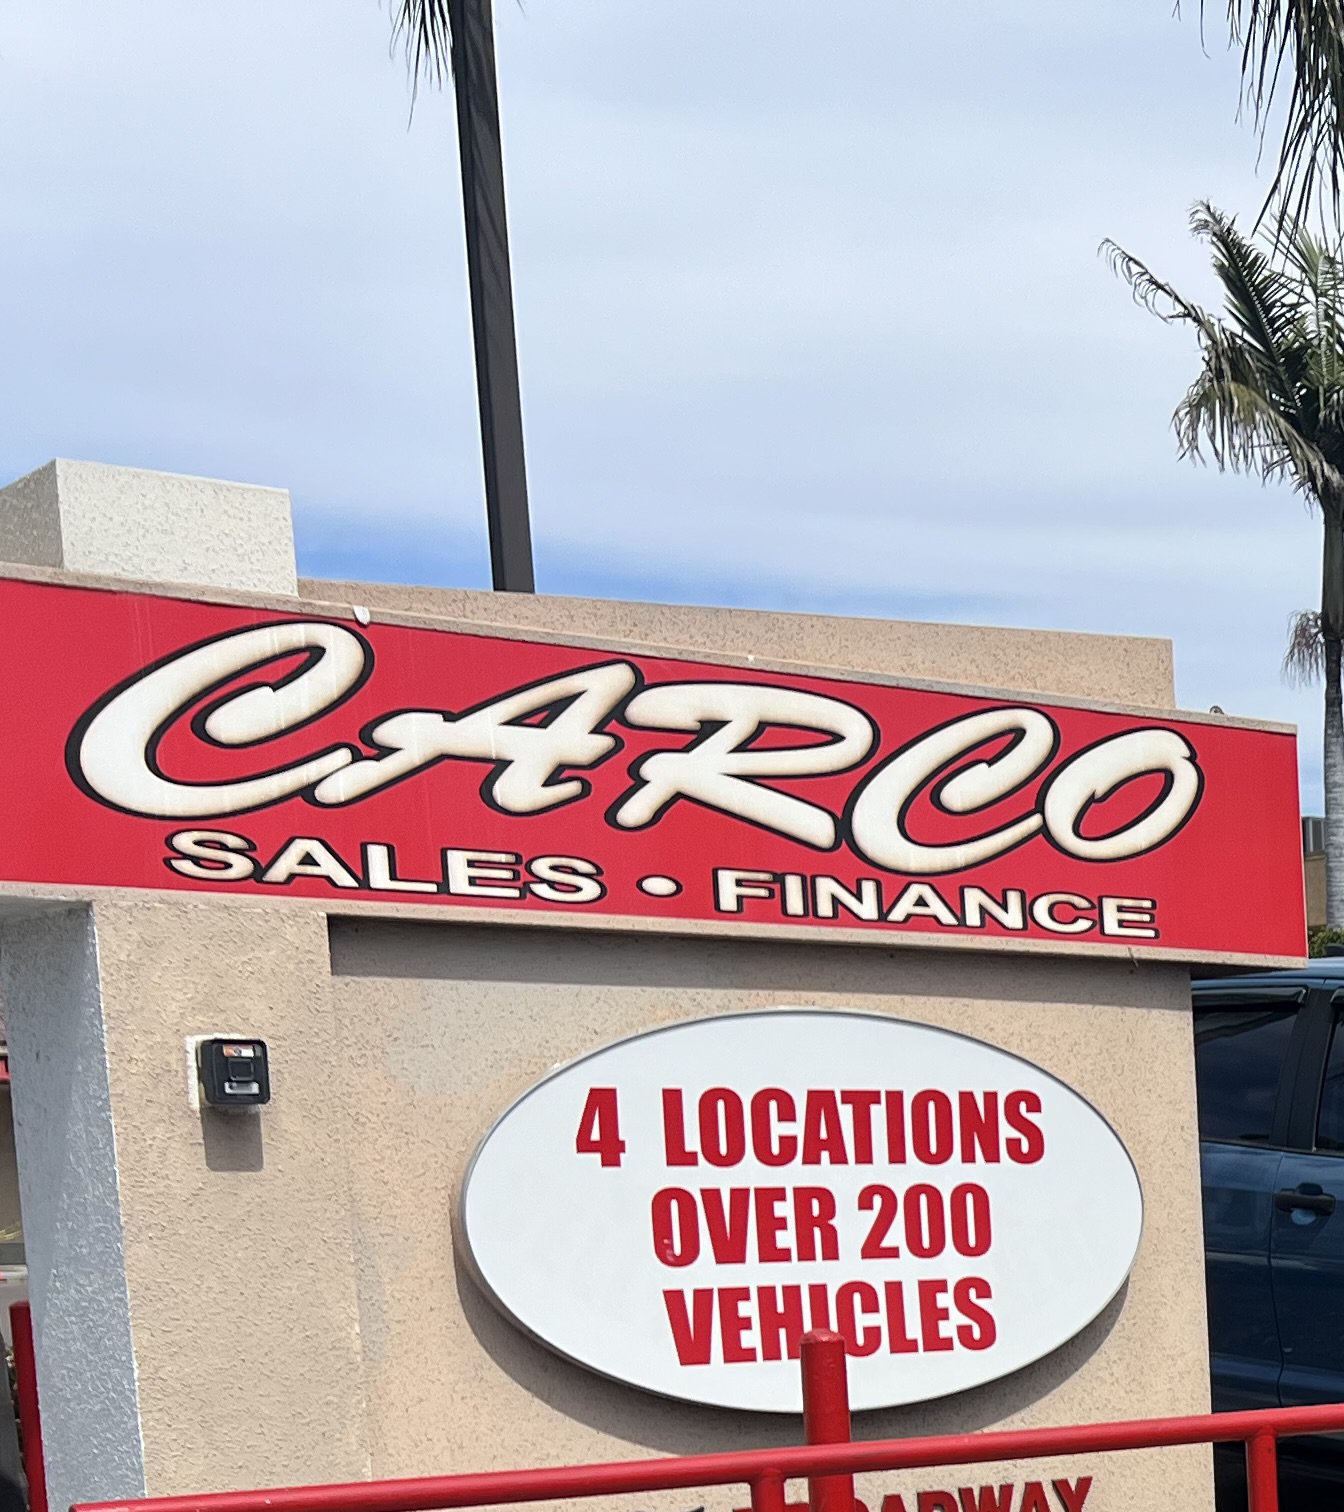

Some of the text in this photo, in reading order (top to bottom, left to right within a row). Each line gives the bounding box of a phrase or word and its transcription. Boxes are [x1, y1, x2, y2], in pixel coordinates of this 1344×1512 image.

[65, 618, 1205, 873] CARCO
[164, 828, 1160, 940] SALES FINANCE
[575, 1086, 1046, 1168] 4 LOCATIONS
[650, 1182, 994, 1267] OVER 200
[663, 1276, 998, 1366] VEHICLES
